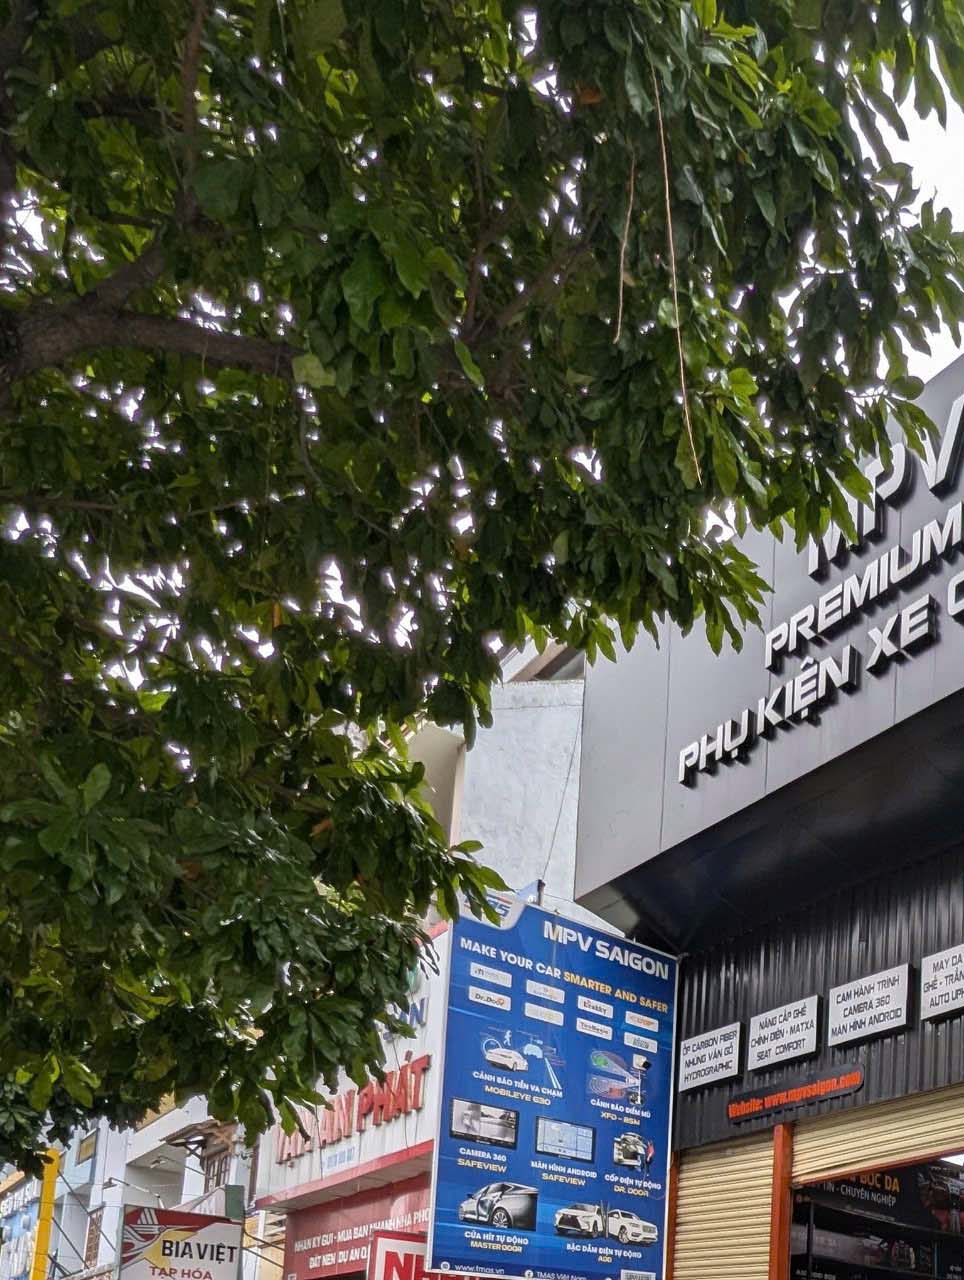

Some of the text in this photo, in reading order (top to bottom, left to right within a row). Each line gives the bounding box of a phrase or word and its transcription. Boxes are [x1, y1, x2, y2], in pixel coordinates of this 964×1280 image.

[678, 709, 757, 785] PHỤ
[755, 645, 858, 730] KIỆN
[866, 595, 937, 677] XE
[543, 920, 669, 981] MPV SAIGON
[932, 957, 950, 973] MAY
[951, 953, 963, 967] DA
[460, 937, 497, 959] MAKE
[500, 951, 533, 971] YOUR
[536, 962, 561, 980] CAR
[564, 970, 613, 996] SMARTER
[614, 988, 638, 1007] AND
[639, 994, 668, 1014] SAFER
[836, 989, 852, 1004] CAM
[843, 994, 891, 1018] CAMERA 360
[929, 992, 950, 1009] AUTO
[868, 1007, 902, 1028] ANDROID
[691, 1036, 719, 1053] CARBON
[756, 1038, 806, 1062] SEAT COMFORT
[459, 1147, 491, 1160] CAMERA
[457, 1158, 508, 1173] SAFEVIEW
[567, 1167, 597, 1179] ANDROID
[542, 1172, 586, 1186] SAFEVIEW
[885, 1175, 900, 1193] DA
[162, 1240, 238, 1264] BIA VIỆT
